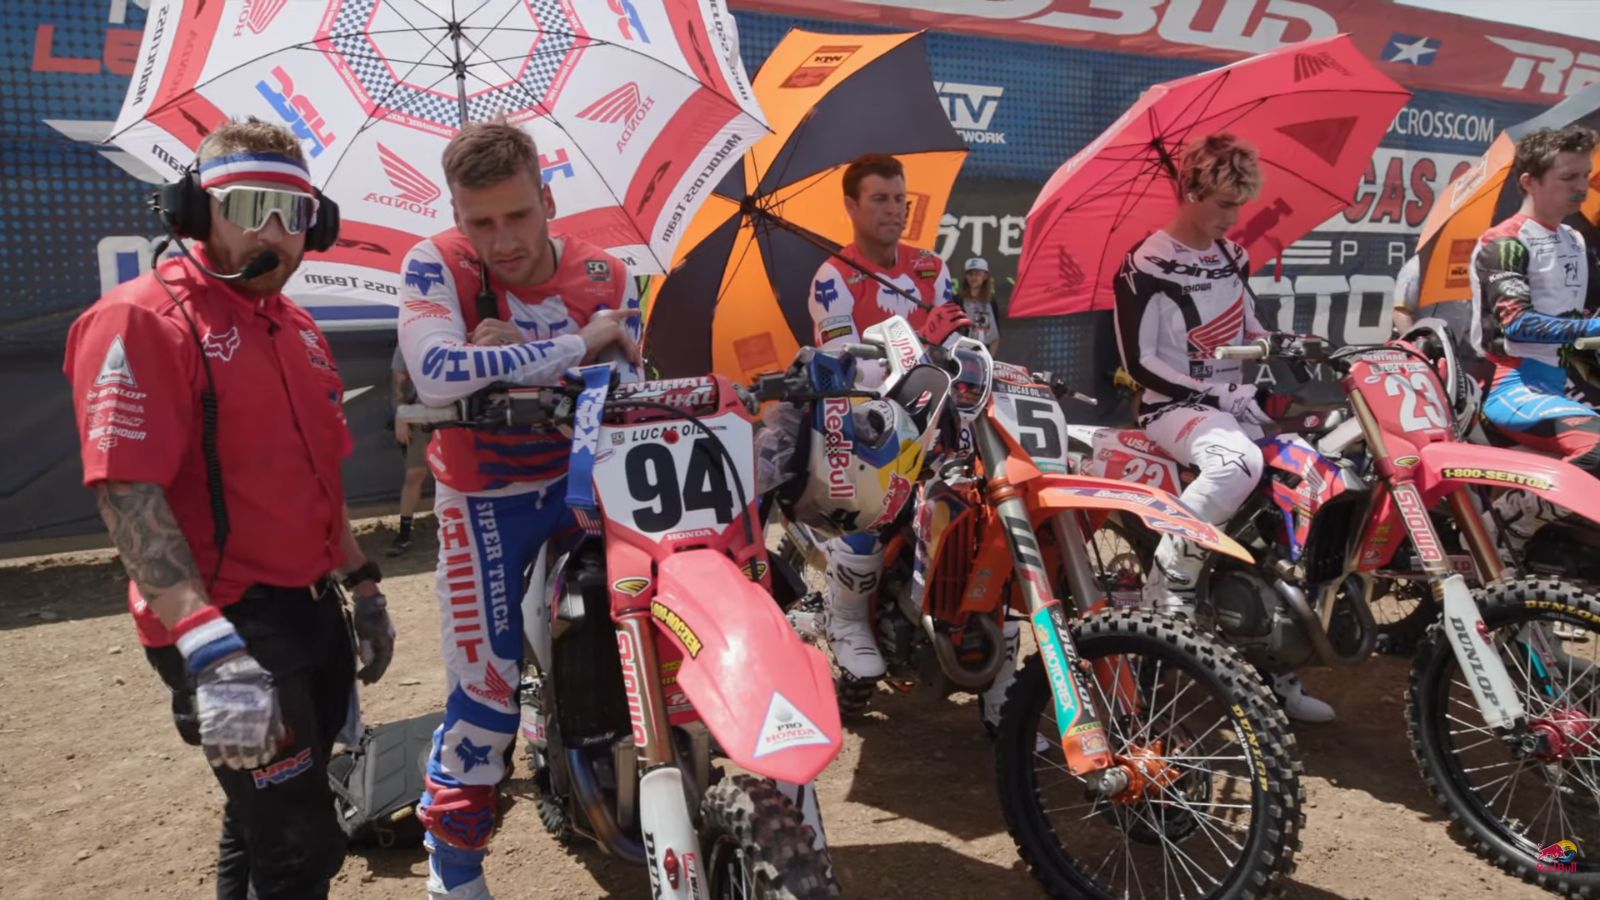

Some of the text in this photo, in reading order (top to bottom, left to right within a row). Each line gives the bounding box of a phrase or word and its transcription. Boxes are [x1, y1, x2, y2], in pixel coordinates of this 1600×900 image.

[1182, 283, 1212, 295] SHOWA
[615, 376, 715, 394] ENTHAL
[1008, 385, 1041, 397] LUCAS OIL
[1384, 371, 1448, 433] 23
[1014, 399, 1062, 459] 5
[1127, 436, 1150, 452] USA
[624, 436, 735, 534] 94
[666, 528, 713, 542] HONDA
[1394, 489, 1442, 562] SHOWA
[488, 562, 510, 638] TRICK
[1042, 643, 1075, 713] MOTOREX
[1450, 615, 1500, 707] DUNLOP
[765, 728, 816, 744] HONDA
[776, 722, 802, 732] PRO
[1231, 703, 1269, 792] DUNLOP
